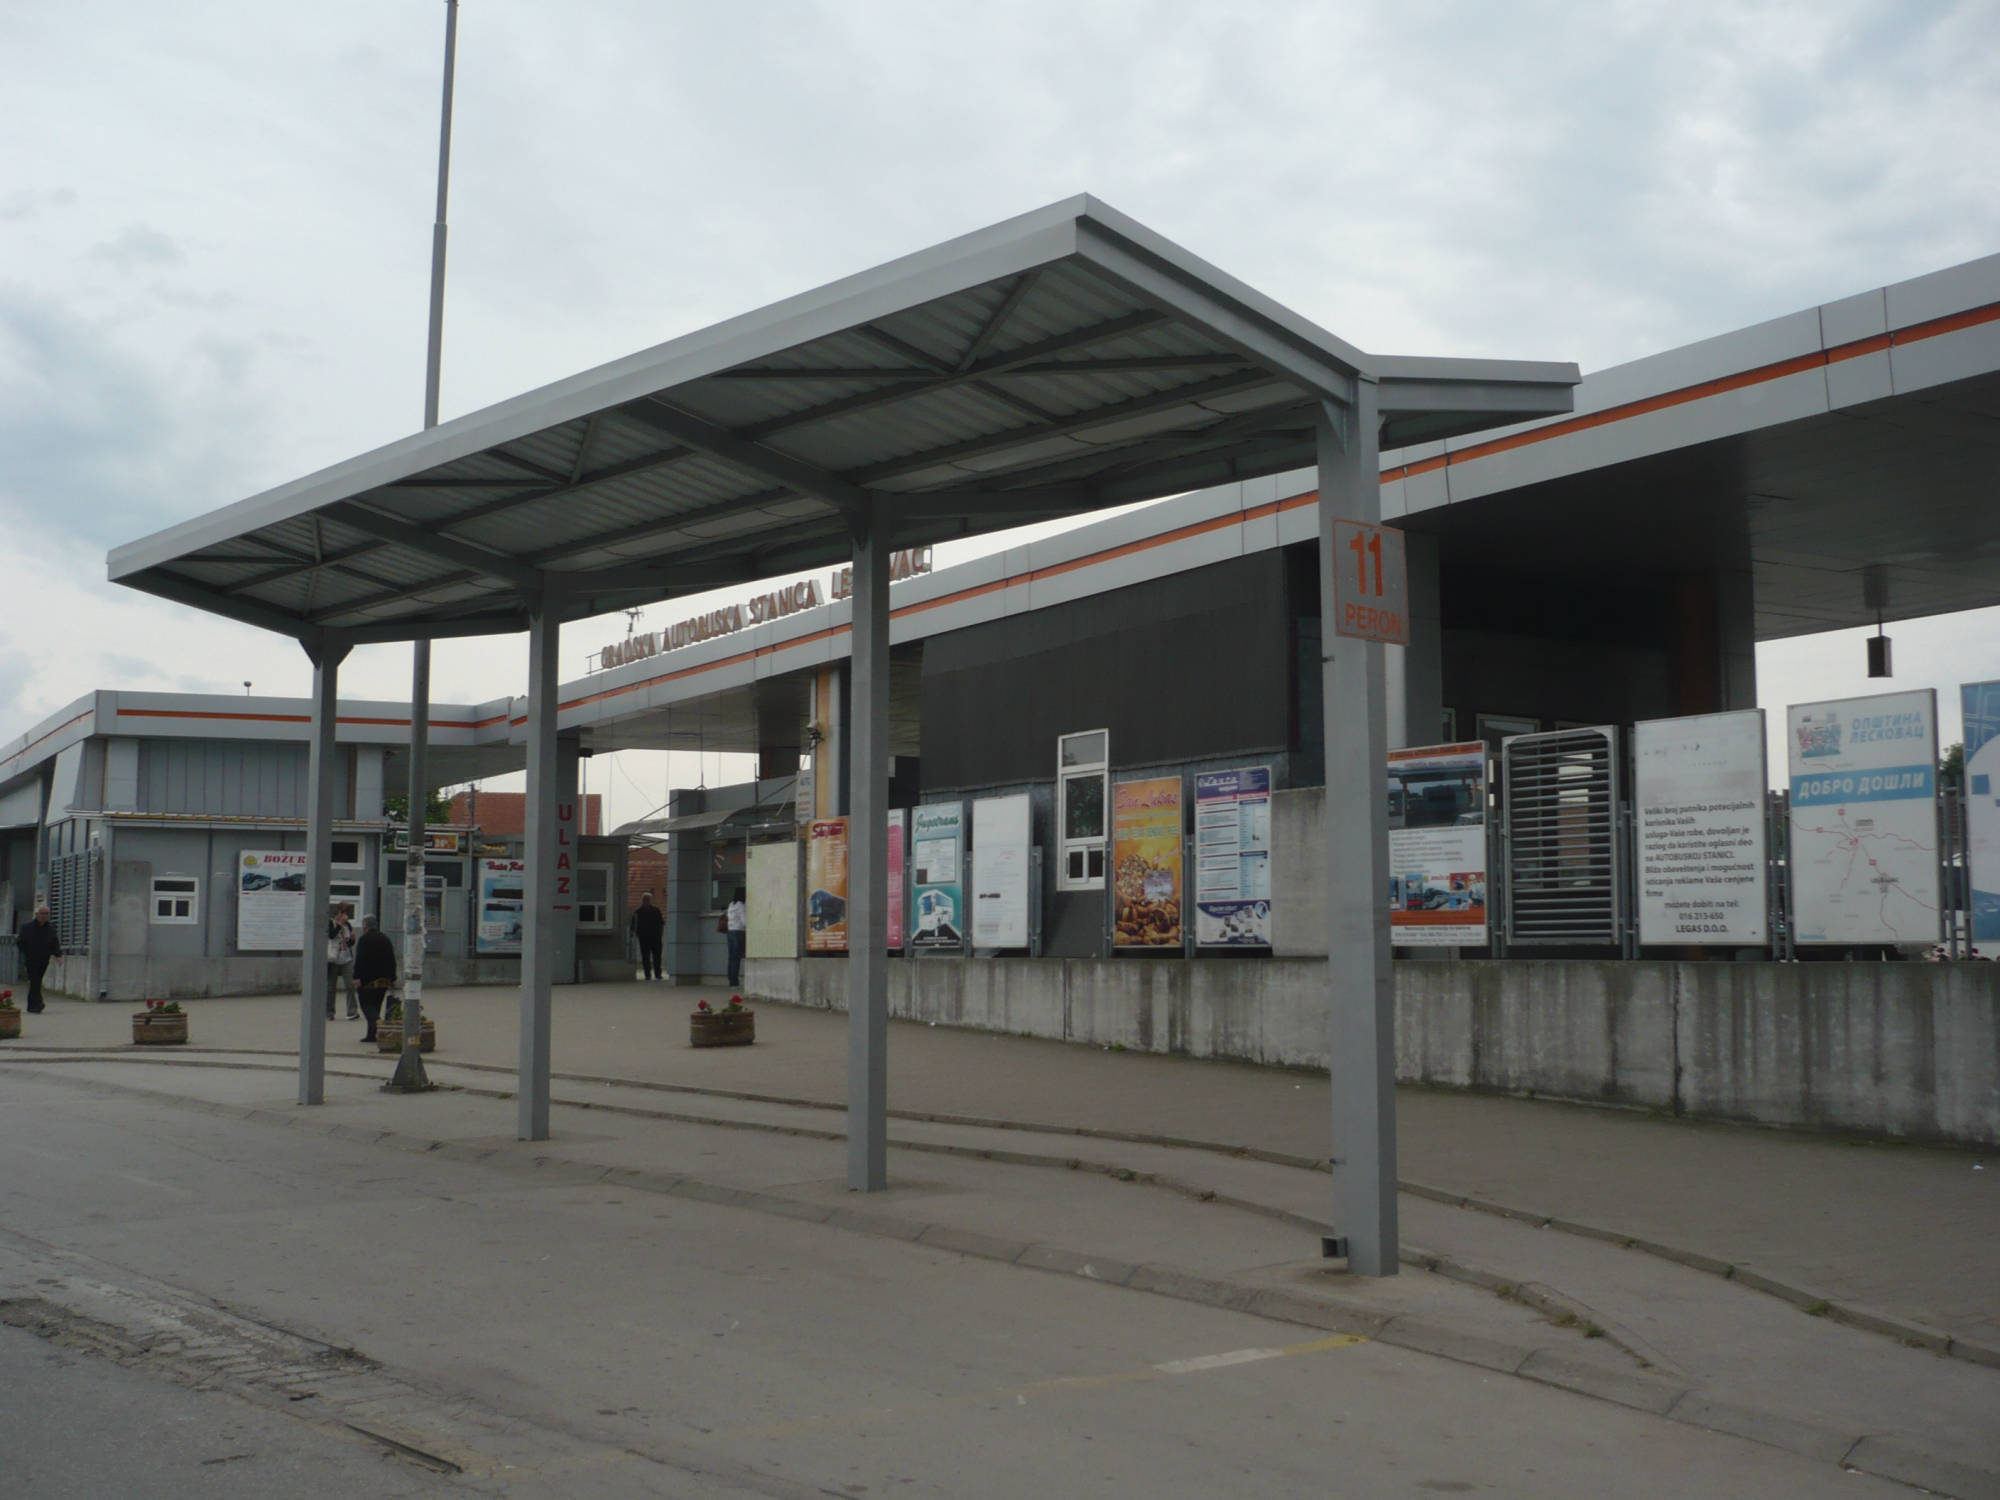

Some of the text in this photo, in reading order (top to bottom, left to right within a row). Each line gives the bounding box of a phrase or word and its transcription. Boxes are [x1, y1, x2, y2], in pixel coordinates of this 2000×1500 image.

[1349, 530, 1383, 597] 11
[662, 604, 743, 652] AUTOBUSKA
[749, 579, 818, 624] STANICA
[831, 547, 924, 599] LEVAC
[1345, 603, 1401, 636] PERON
[1850, 725, 1924, 744] ЛЕСКОВАЦ
[1852, 712, 1922, 730] ОПШТИНА
[1798, 772, 1925, 800] ДОБРО ДОШЛИ
[557, 803, 573, 894] ULAZ
[1675, 925, 1702, 933] LEGAS
